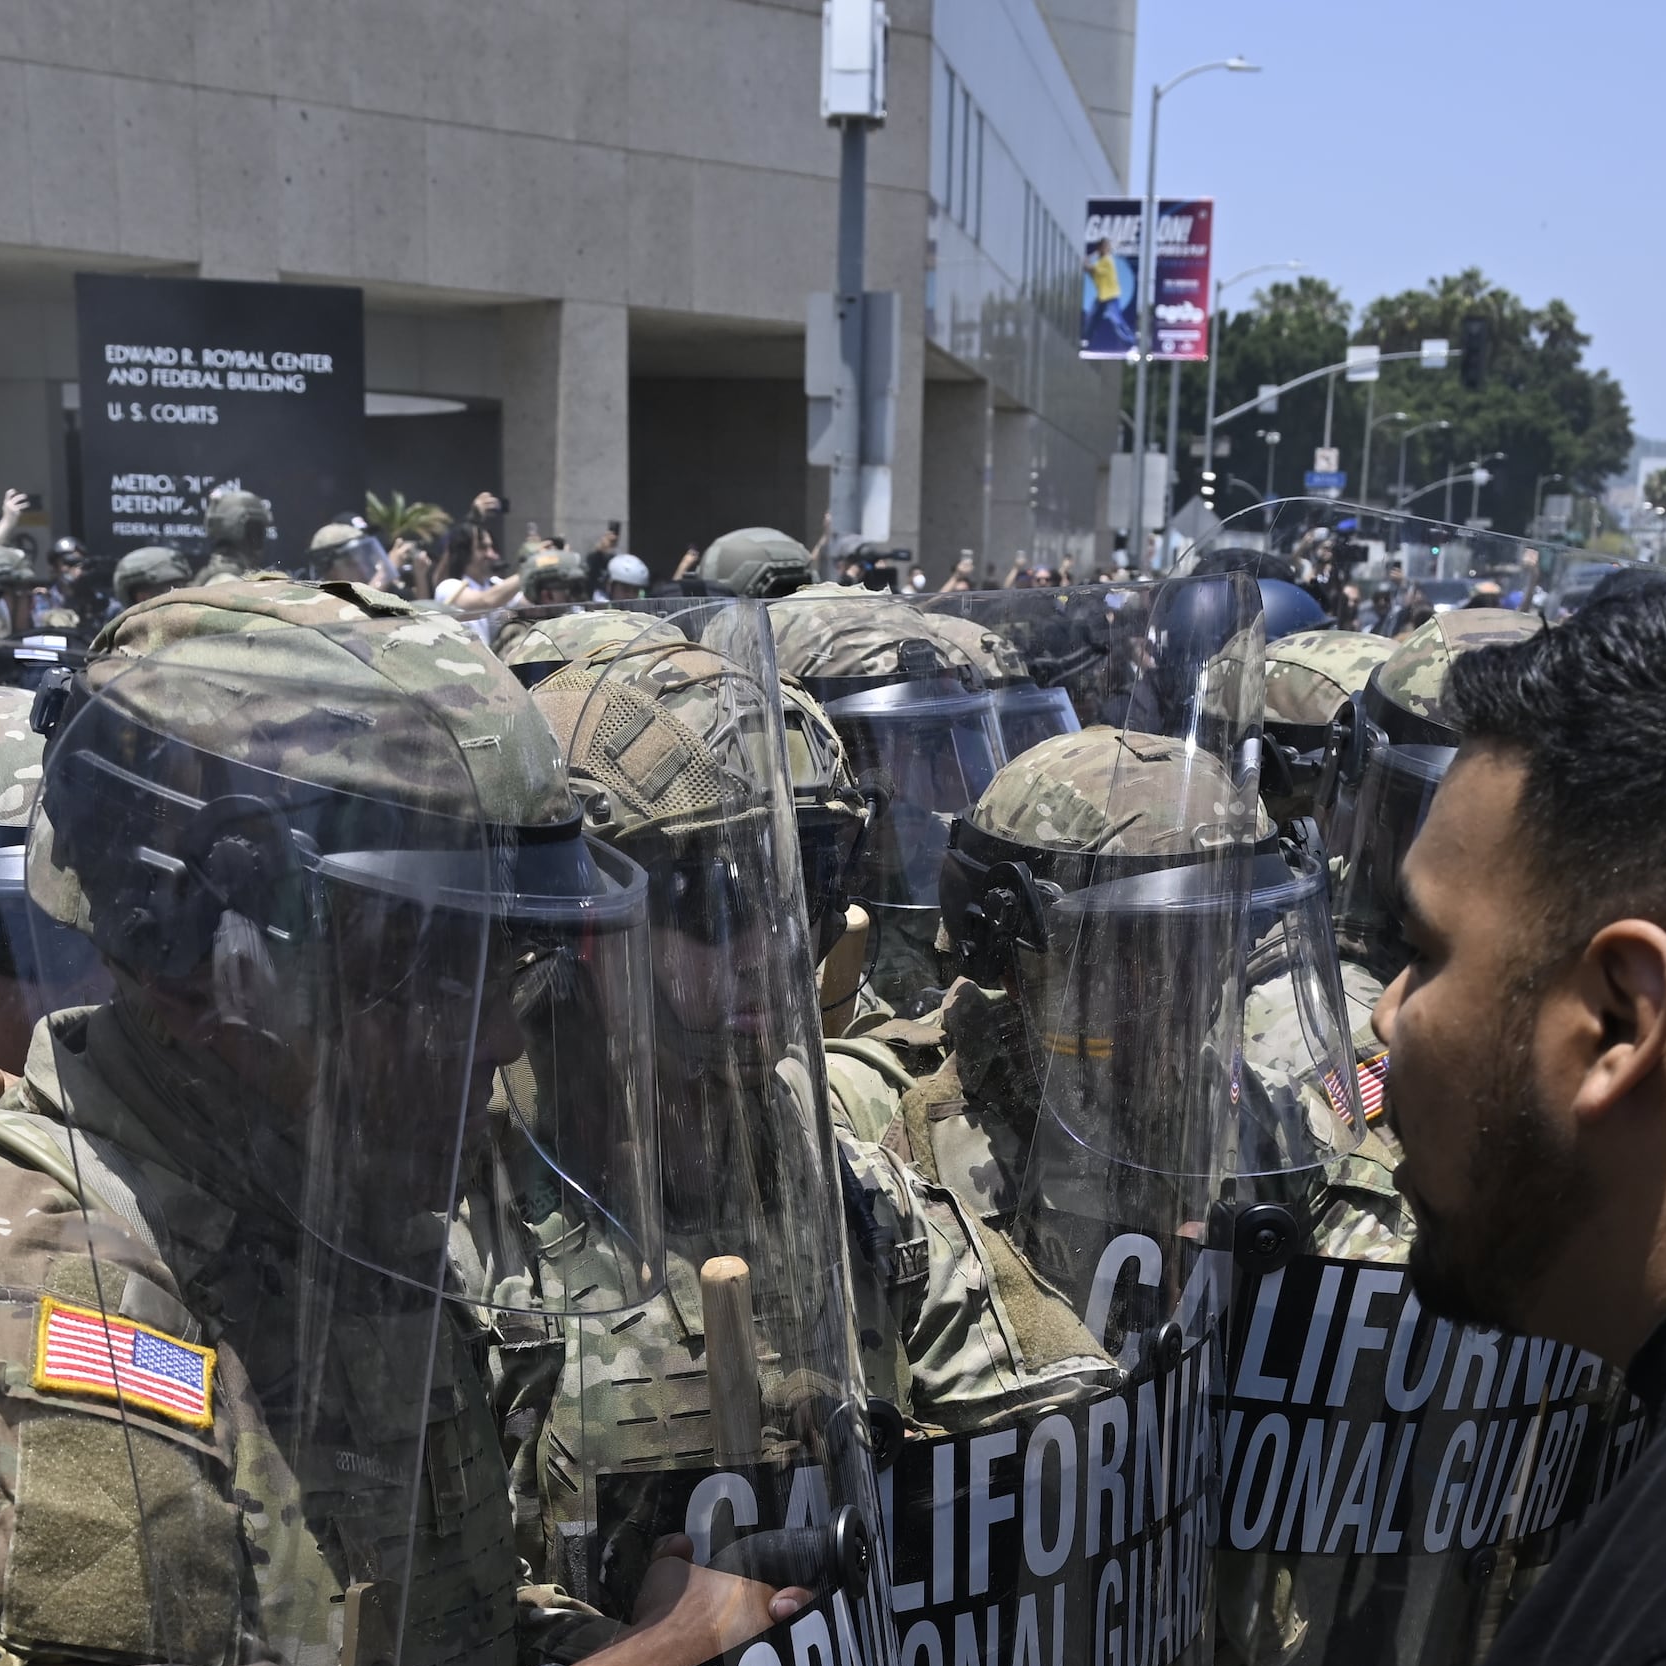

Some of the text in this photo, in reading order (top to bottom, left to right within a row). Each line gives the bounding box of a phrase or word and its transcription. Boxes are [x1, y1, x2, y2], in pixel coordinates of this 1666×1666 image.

[105, 345, 333, 372] EDWARD R. ROYBAL CENTER
[107, 368, 306, 393] AND FEDERAL BUILDING
[107, 402, 219, 425] U. S. COURTS
[1219, 1409, 1418, 1554] IONAL
[1424, 1403, 1589, 1554] GUARD
